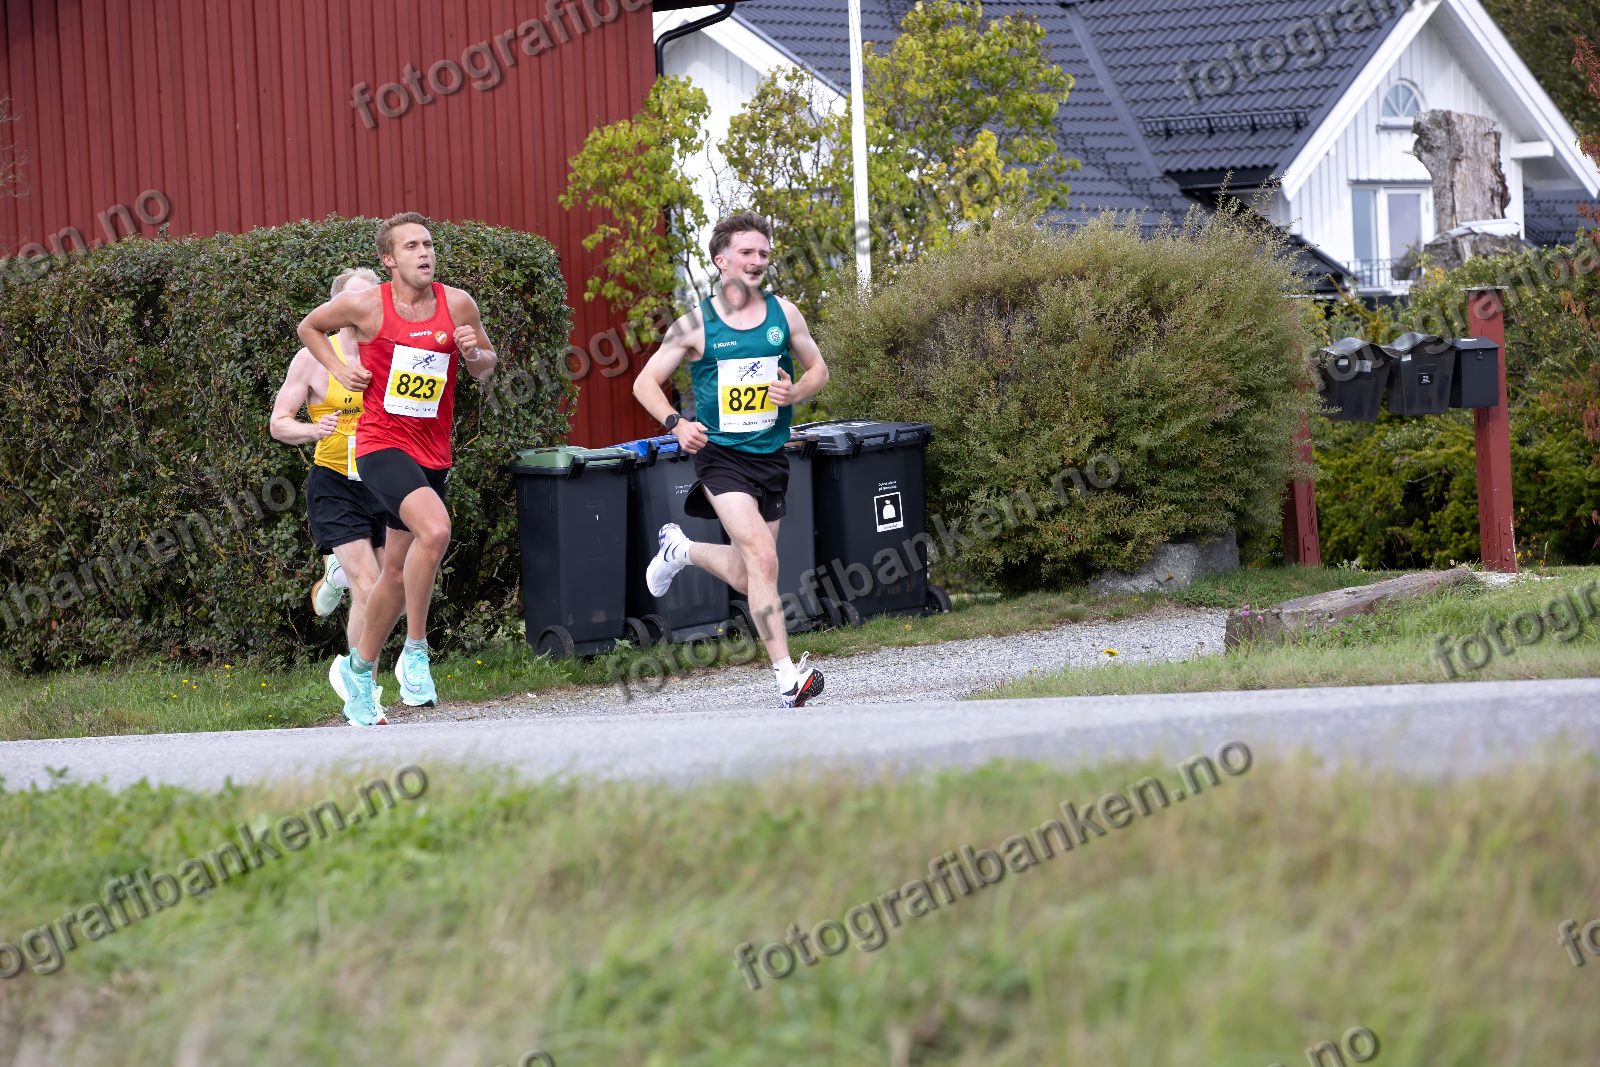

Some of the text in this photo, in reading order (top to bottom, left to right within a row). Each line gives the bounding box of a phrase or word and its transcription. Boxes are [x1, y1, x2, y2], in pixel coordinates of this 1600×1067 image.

[717, 340, 737, 349] KUKRI
[396, 373, 437, 399] 823
[728, 386, 769, 412] 827
